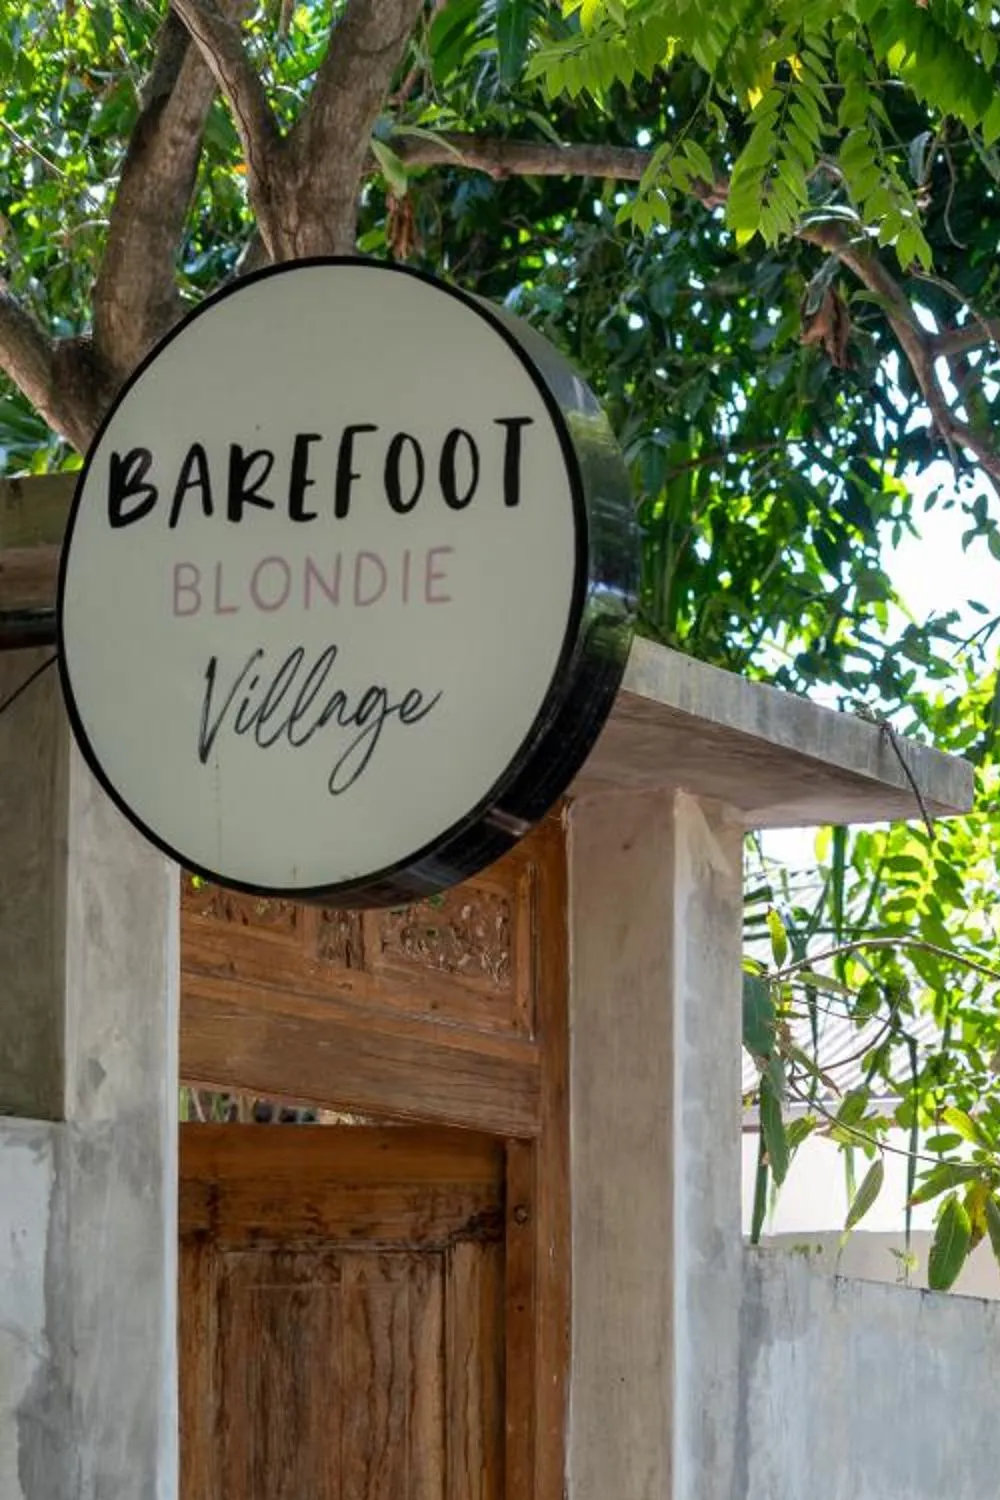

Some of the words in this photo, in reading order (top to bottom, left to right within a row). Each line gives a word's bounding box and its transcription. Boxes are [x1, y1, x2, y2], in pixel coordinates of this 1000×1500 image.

[108, 416, 534, 529] BAREFOOT
[171, 545, 455, 617] BLONDIE
[199, 644, 443, 796] Village
